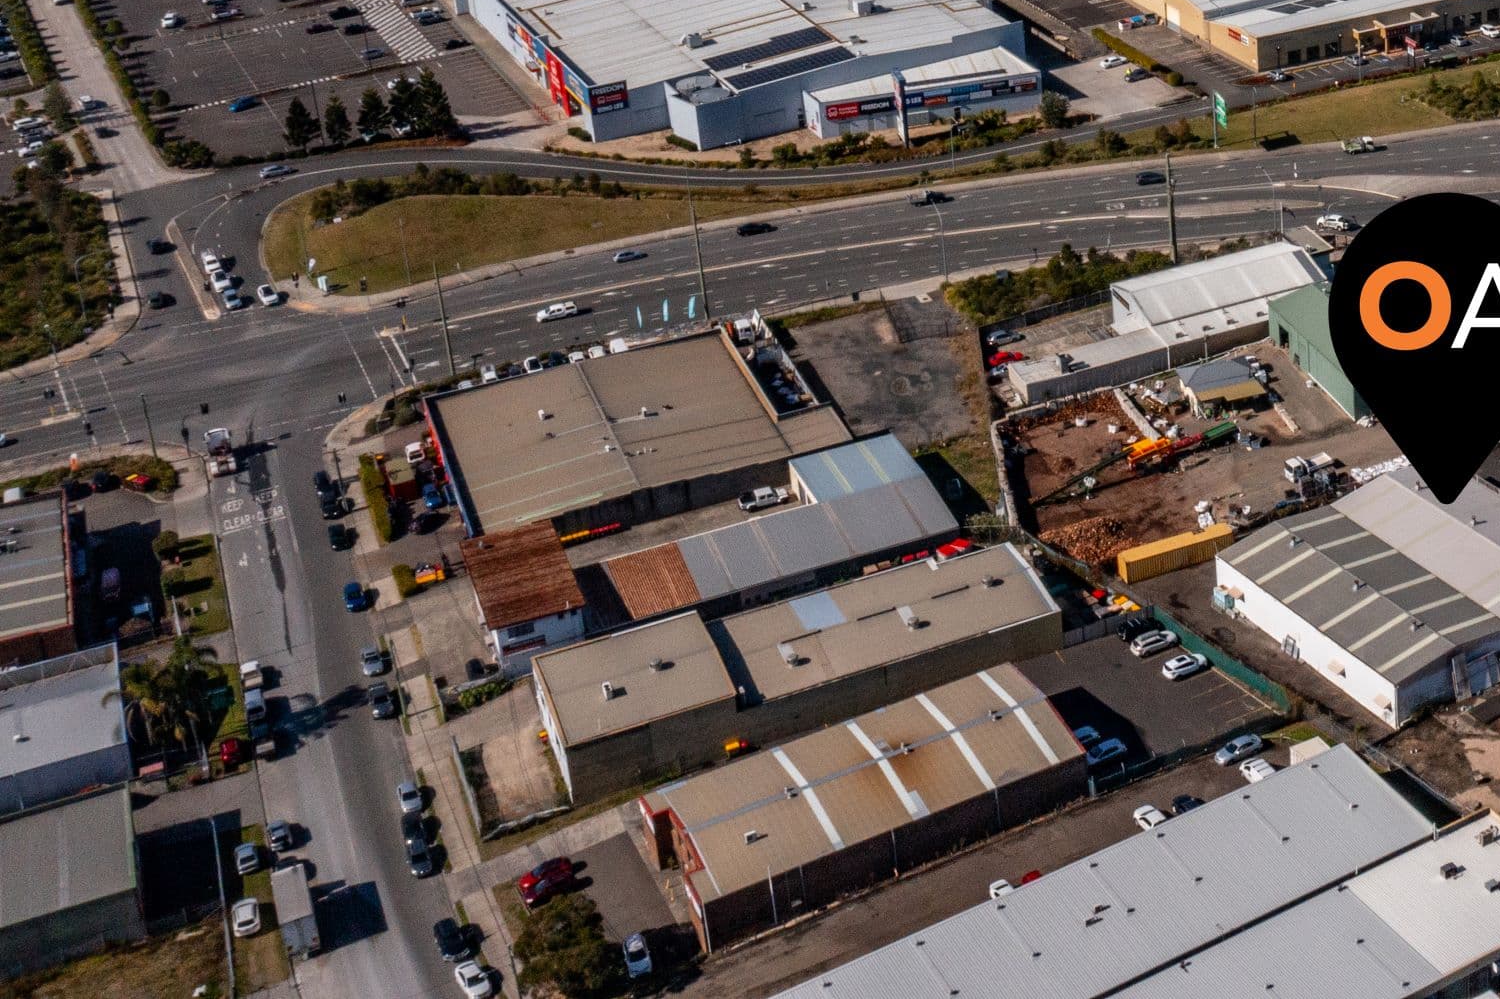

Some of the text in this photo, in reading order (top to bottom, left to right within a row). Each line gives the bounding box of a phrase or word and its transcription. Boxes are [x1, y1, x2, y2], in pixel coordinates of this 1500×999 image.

[592, 83, 625, 96] FREEDOM
[861, 101, 890, 111] FREEDOM
[255, 489, 278, 503] KEEP
[222, 498, 244, 513] KEEP
[224, 513, 252, 530] CLEAR
